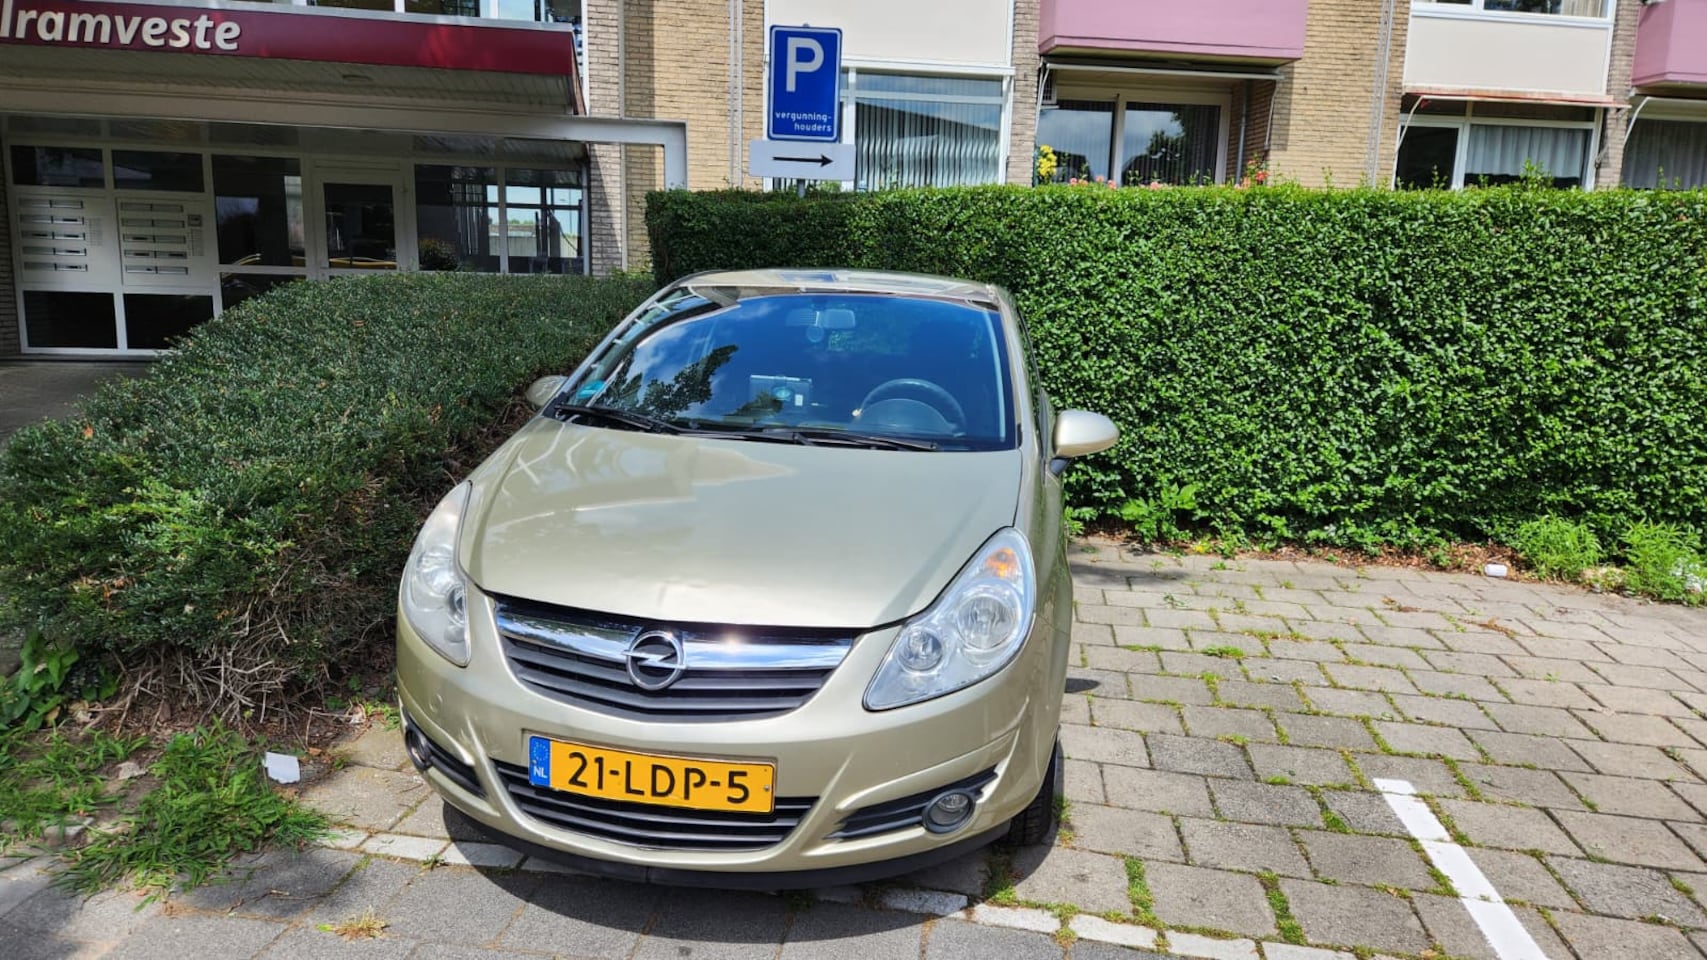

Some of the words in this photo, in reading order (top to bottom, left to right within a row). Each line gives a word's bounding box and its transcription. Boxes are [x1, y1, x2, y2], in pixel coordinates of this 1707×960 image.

[785, 36, 825, 92] P
[775, 111, 832, 123] vergunning-
[794, 122, 832, 132] houders
[533, 765, 549, 779] NL
[568, 751, 750, 804] 21-LDP-5
